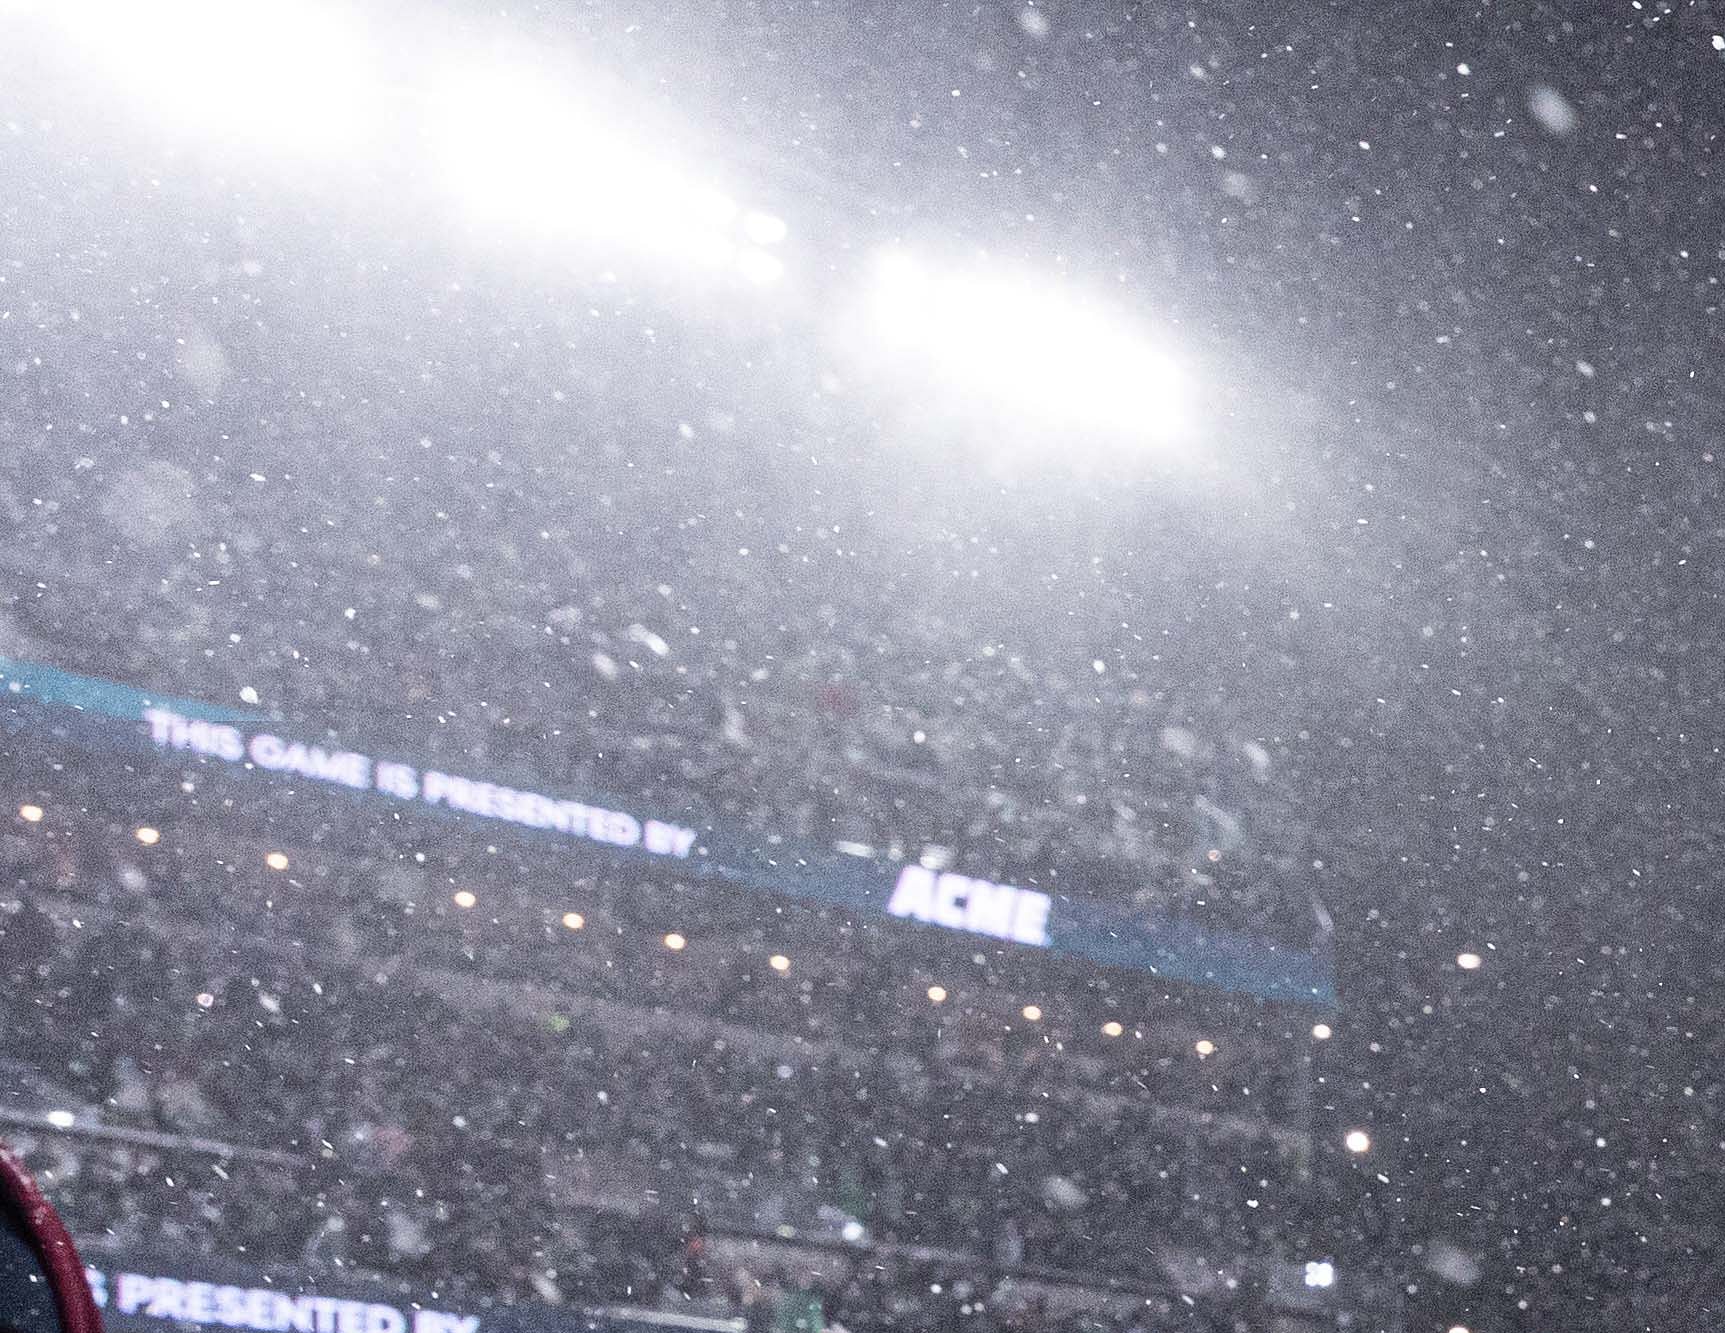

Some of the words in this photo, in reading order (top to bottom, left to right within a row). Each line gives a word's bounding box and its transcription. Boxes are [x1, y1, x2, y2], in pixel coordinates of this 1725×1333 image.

[143, 706, 244, 762] THIS
[249, 733, 371, 790] GAME
[376, 760, 420, 799] IS
[424, 769, 643, 848] PRESENTED
[643, 818, 699, 859] BY
[887, 864, 1052, 947] ACME
